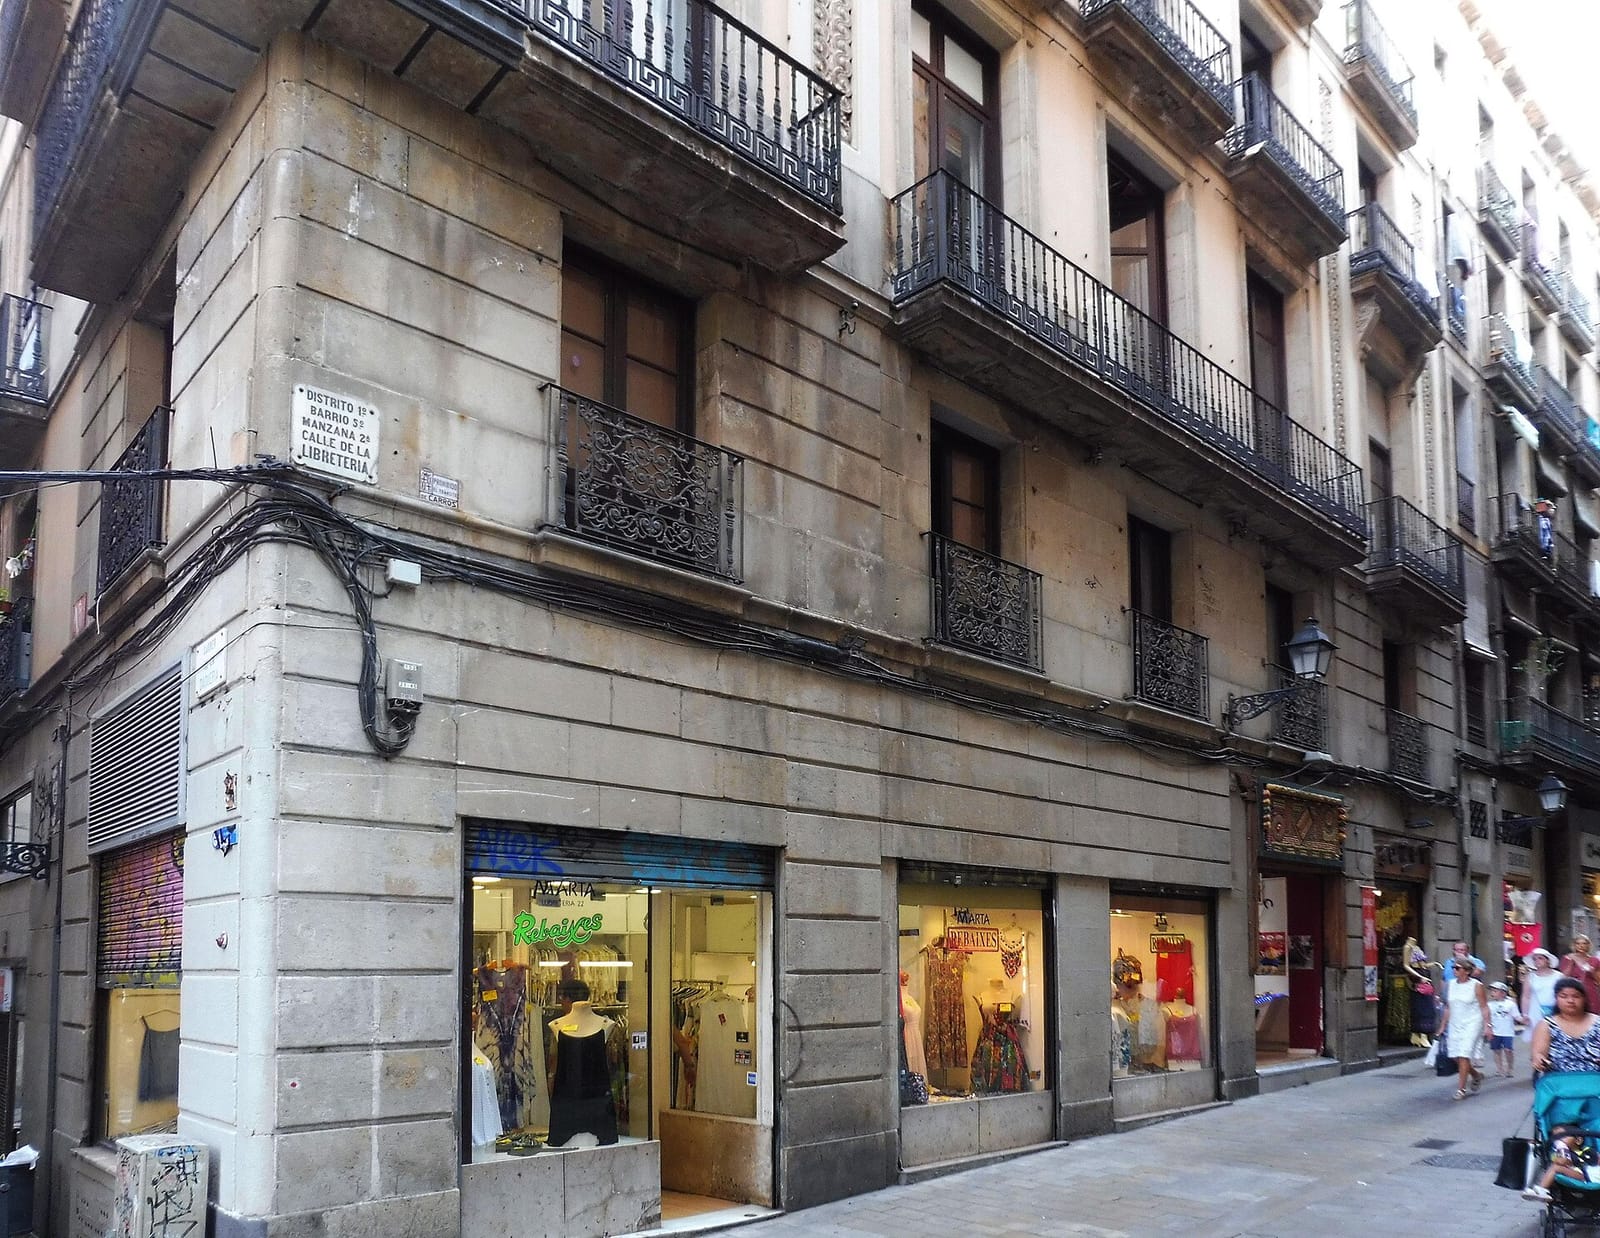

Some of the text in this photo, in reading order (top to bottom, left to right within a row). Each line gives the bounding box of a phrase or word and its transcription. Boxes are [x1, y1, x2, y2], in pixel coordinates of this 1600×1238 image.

[307, 390, 354, 413] DISTRITO
[310, 405, 349, 426] BARRIO
[302, 416, 356, 441] MANZANA
[302, 429, 370, 460] CALLE DE LA
[302, 444, 369, 475] LIBRETERIA
[428, 494, 457, 508] CARROS
[534, 880, 596, 899] MARTA
[513, 910, 603, 948] Rebaixes
[957, 911, 991, 925] MARTA
[950, 931, 997, 948] REBAIXES
